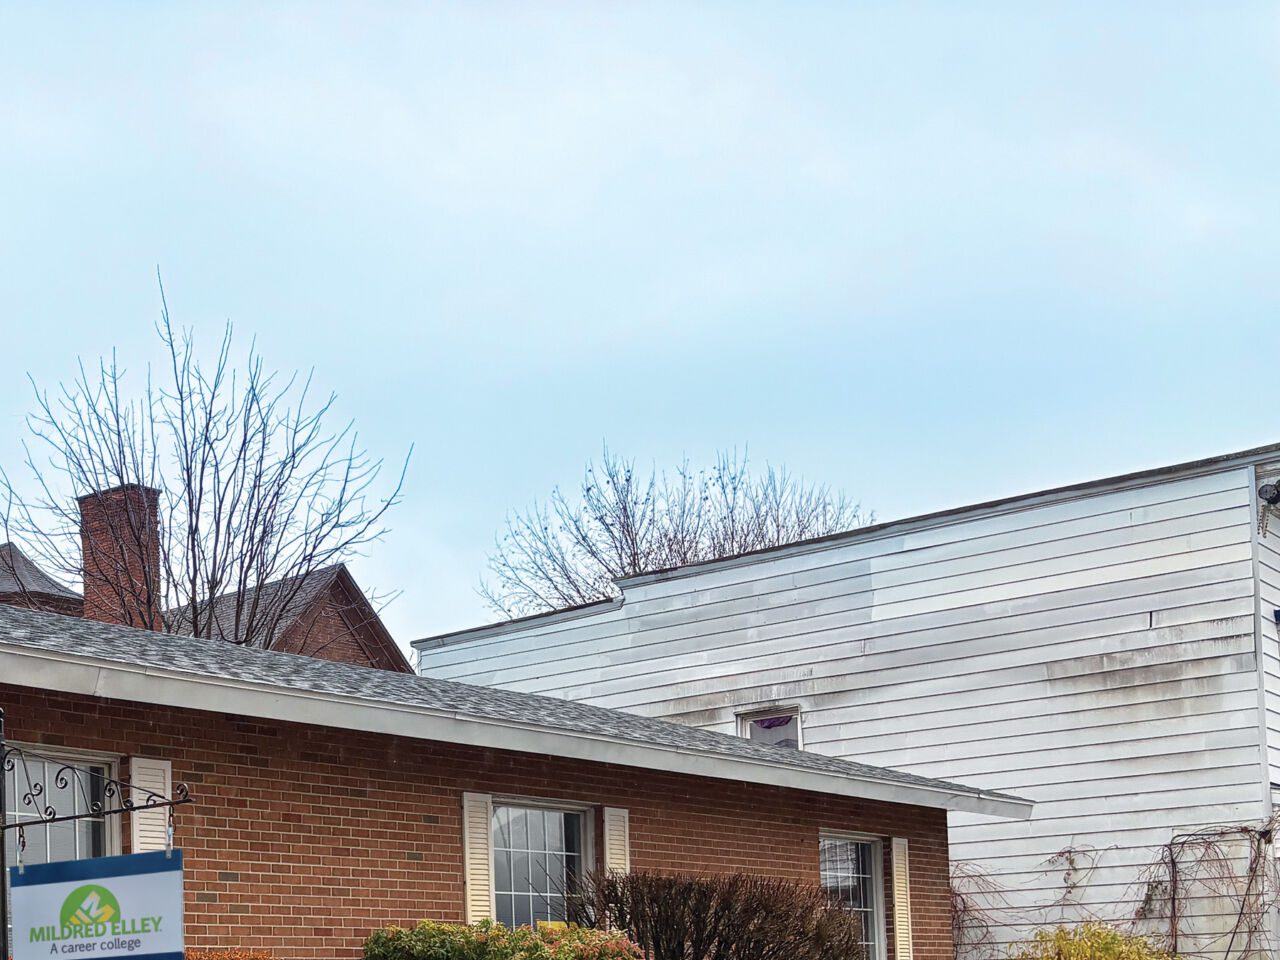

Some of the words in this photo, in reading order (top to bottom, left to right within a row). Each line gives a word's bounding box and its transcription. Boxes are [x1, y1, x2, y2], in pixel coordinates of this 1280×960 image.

[29, 921, 107, 943] MILDRED
[111, 916, 162, 936] ELLEY
[50, 943, 58, 955] A
[61, 943, 95, 954] career
[100, 937, 141, 951] college
